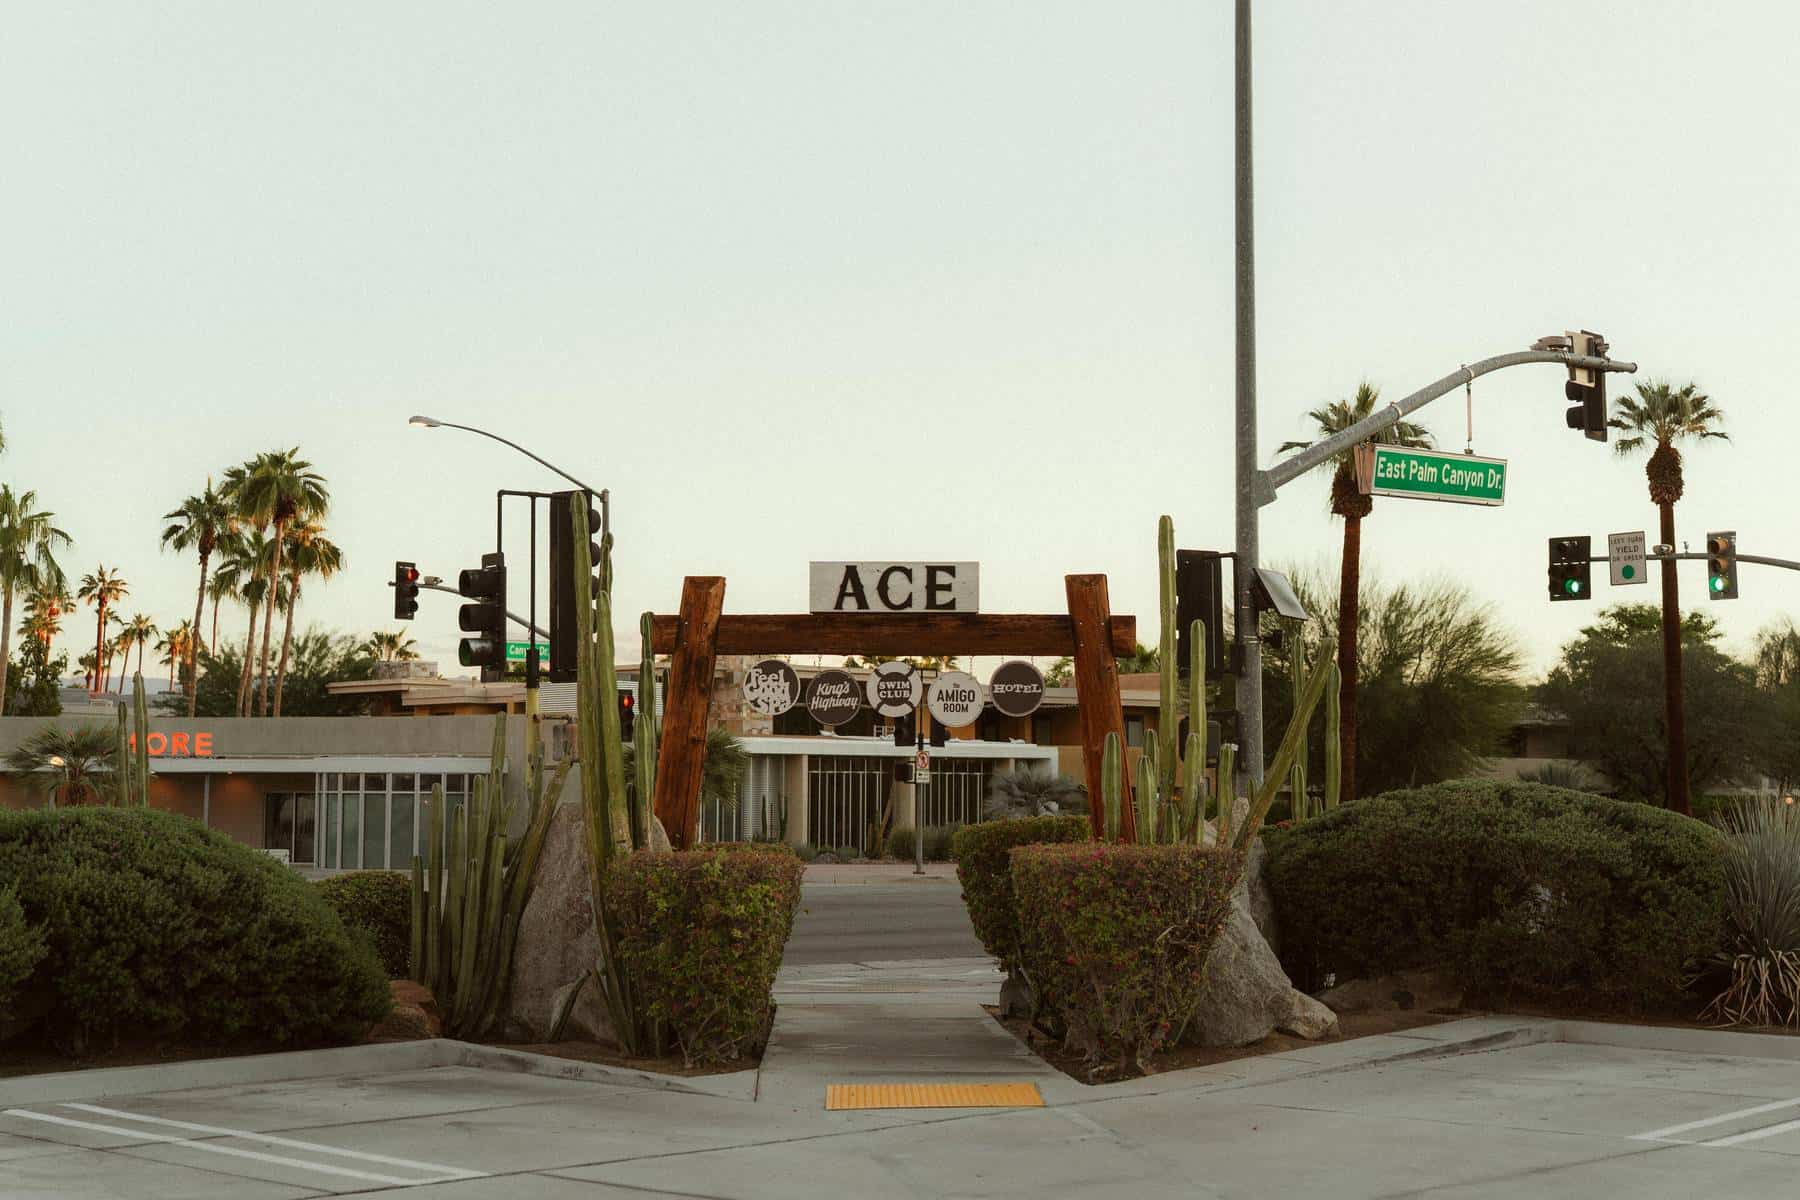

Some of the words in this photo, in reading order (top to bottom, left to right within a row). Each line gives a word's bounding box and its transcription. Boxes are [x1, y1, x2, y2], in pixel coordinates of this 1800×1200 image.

[1377, 456, 1406, 479] East
[1409, 460, 1438, 483] Palm
[1441, 464, 1484, 491] Canyon
[1487, 468, 1502, 489] Dr.
[833, 565, 956, 610] ACE
[750, 667, 785, 688] Feel
[816, 681, 850, 699] King's
[879, 681, 910, 690] SWIM
[993, 684, 1042, 694] HOTEL
[879, 690, 910, 698] CLUB
[936, 689, 976, 702] AMIGO
[810, 695, 859, 711] Highway
[943, 703, 969, 713] ROOM
